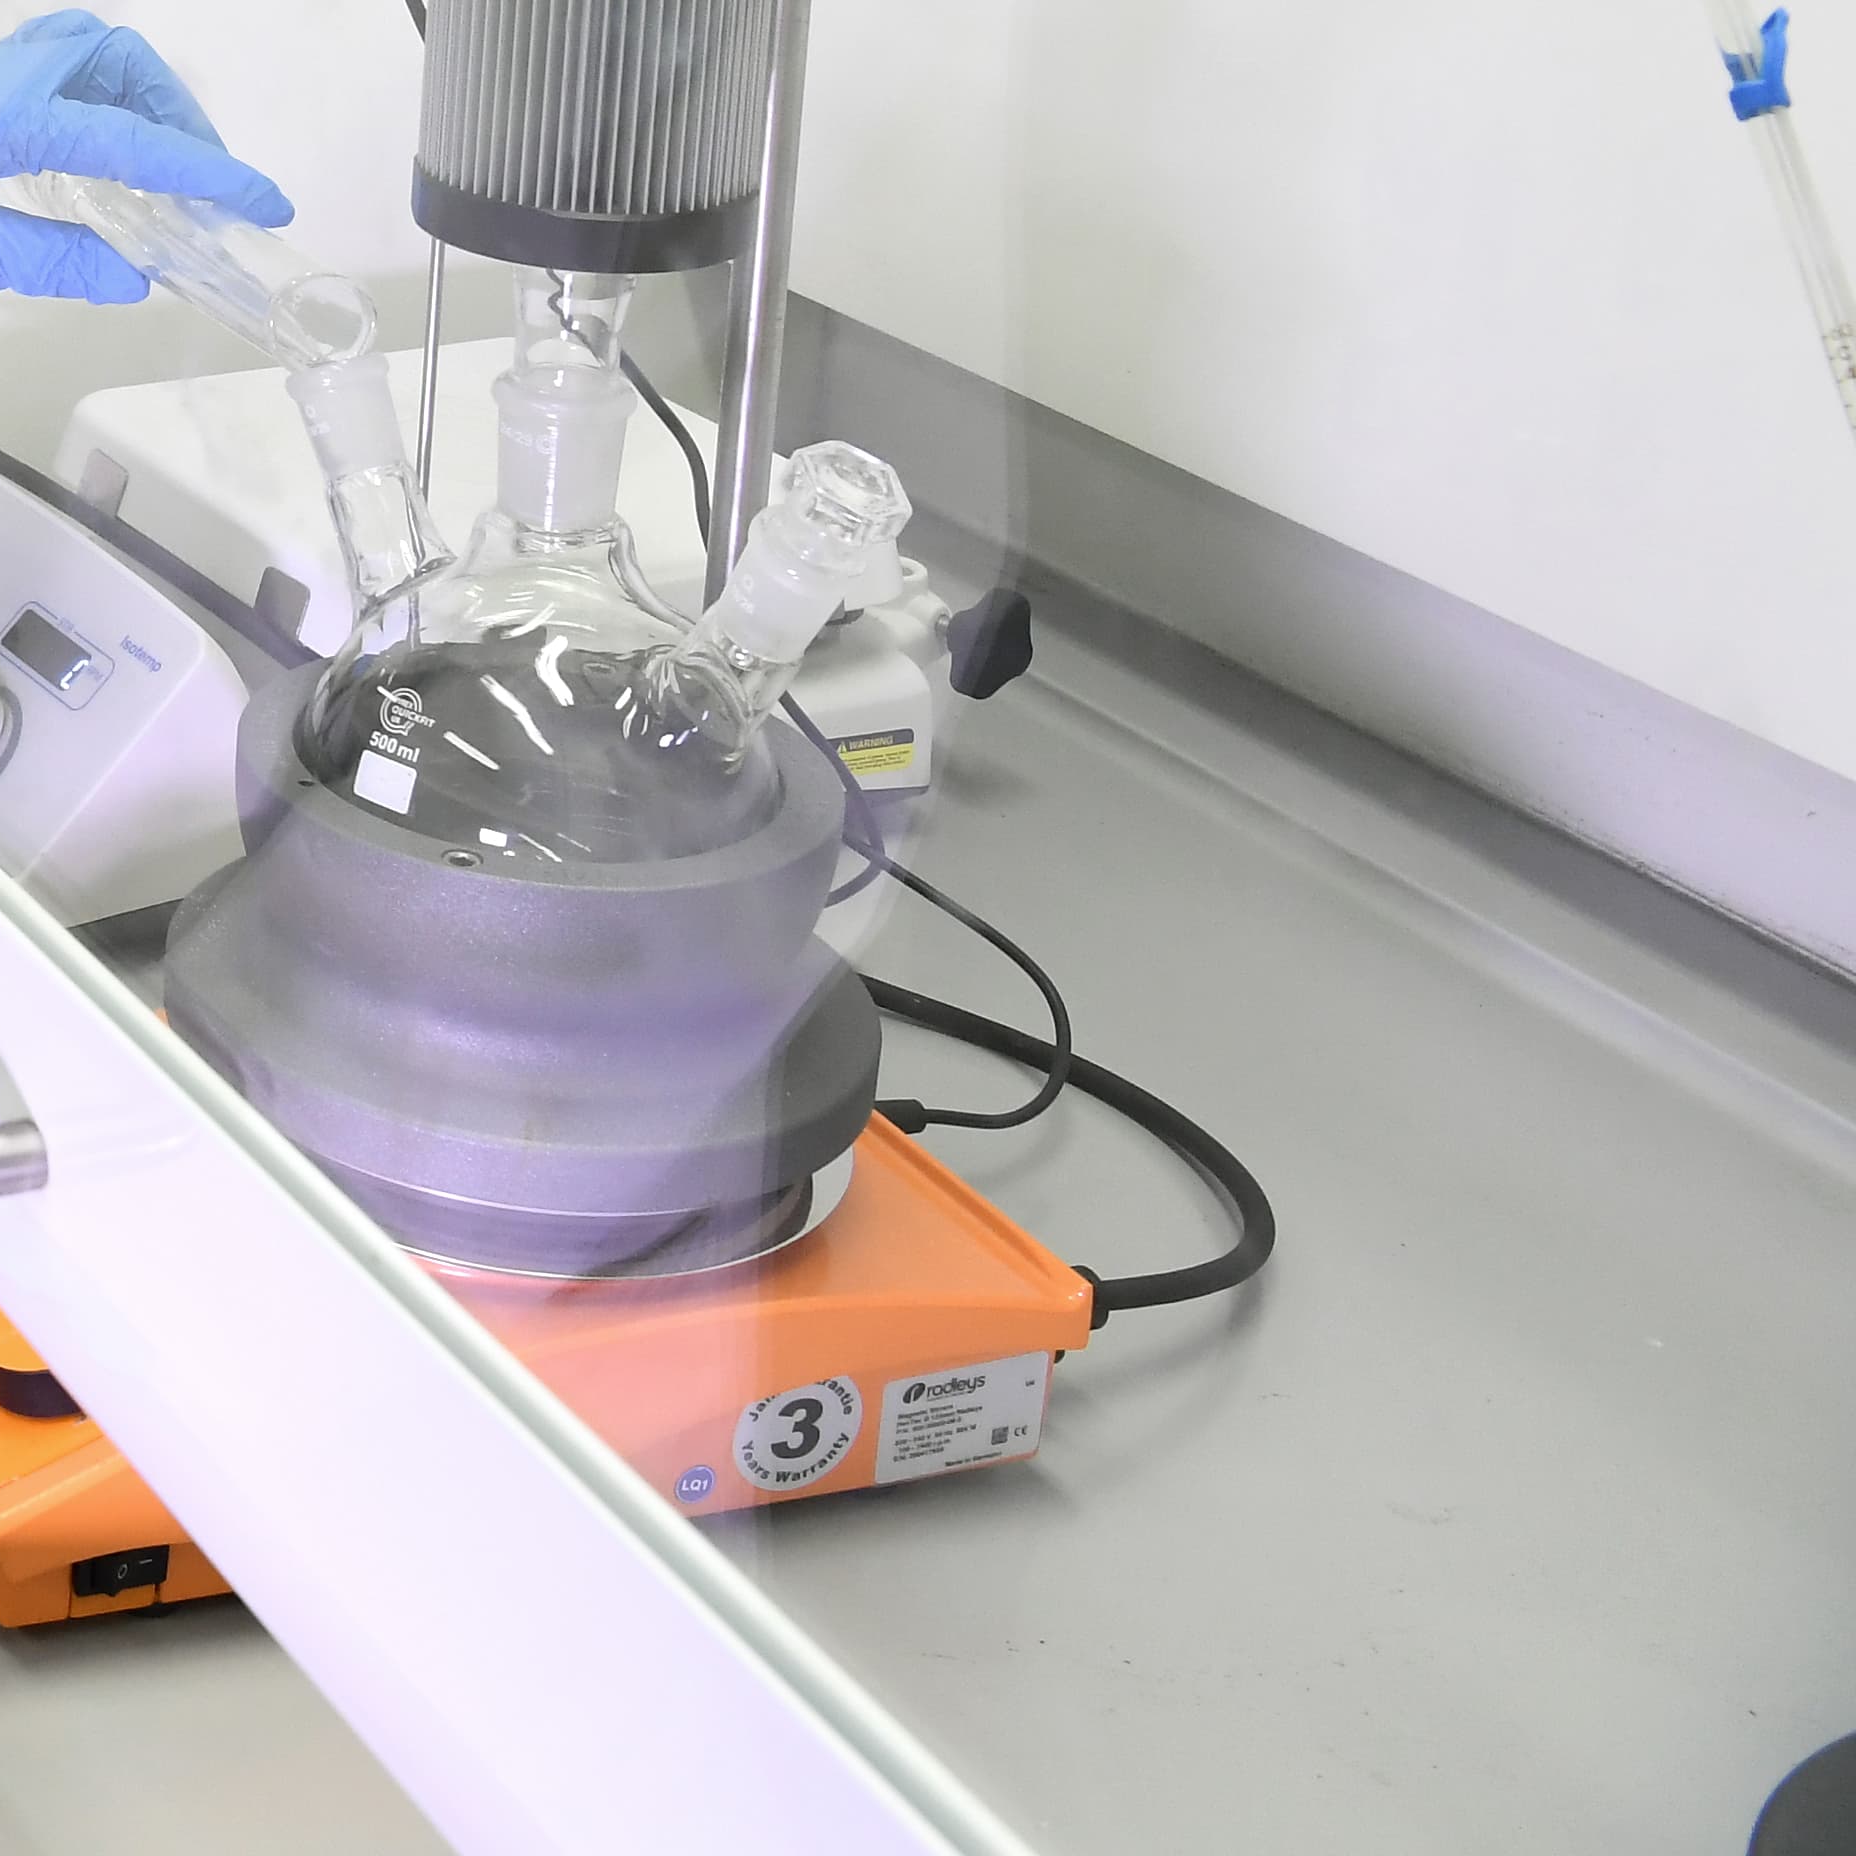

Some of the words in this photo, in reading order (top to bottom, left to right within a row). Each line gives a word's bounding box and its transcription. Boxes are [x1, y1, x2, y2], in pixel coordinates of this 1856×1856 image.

[119, 635, 164, 674] Isotemp
[391, 705, 437, 728] QUICKFIT
[369, 731, 398, 753] 500
[397, 745, 421, 763] ml
[926, 1375, 986, 1398] radleys
[769, 1398, 824, 1460] 3
[741, 1440, 771, 1480] Years
[775, 1432, 851, 1483] Warranty
[681, 1479, 708, 1491] LQ1
